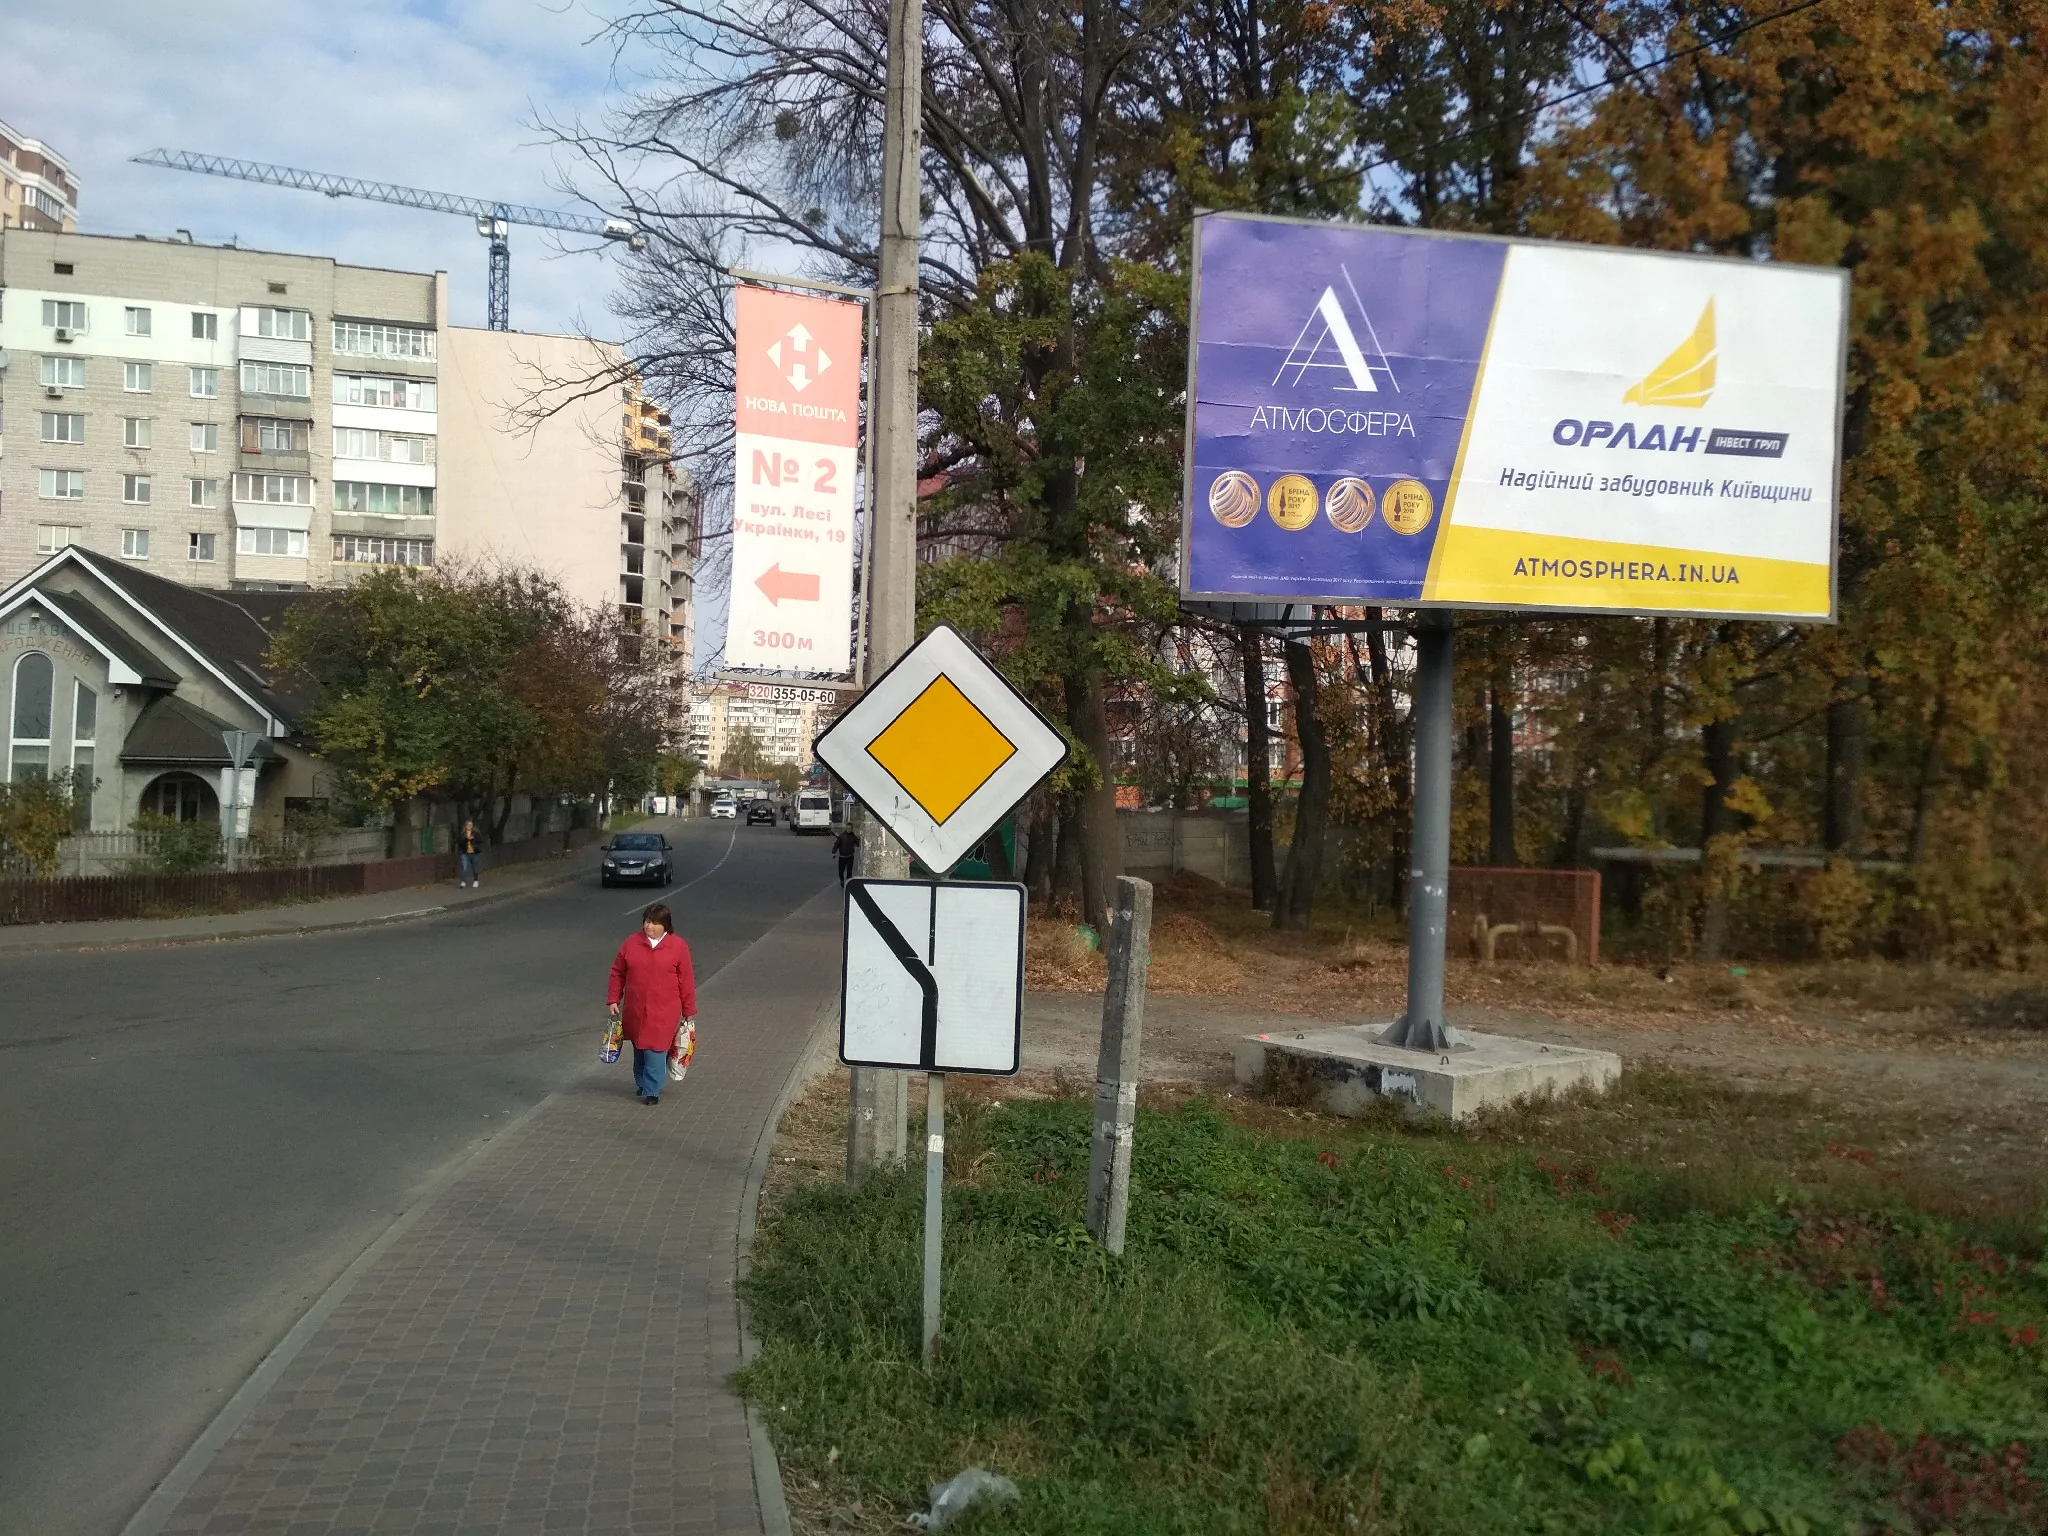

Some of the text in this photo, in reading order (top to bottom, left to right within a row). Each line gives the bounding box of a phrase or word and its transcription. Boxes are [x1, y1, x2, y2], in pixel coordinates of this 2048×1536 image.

[745, 395, 847, 423] НОВА ПОШТА
[1250, 405, 1416, 438] АТМОСФЕРА
[1715, 436, 1751, 449] ІНВЕСТ
[1753, 438, 1781, 451] ГРУП
[751, 449, 838, 494] № 2
[1500, 467, 1813, 504] Надійний забудовник Київщини
[750, 503, 832, 522] вул. Лесі
[734, 518, 846, 543] Українки, 19
[1514, 557, 1740, 584] ATMOSPHERA.IN.UA
[7, 622, 70, 637] ЦЕРКВА
